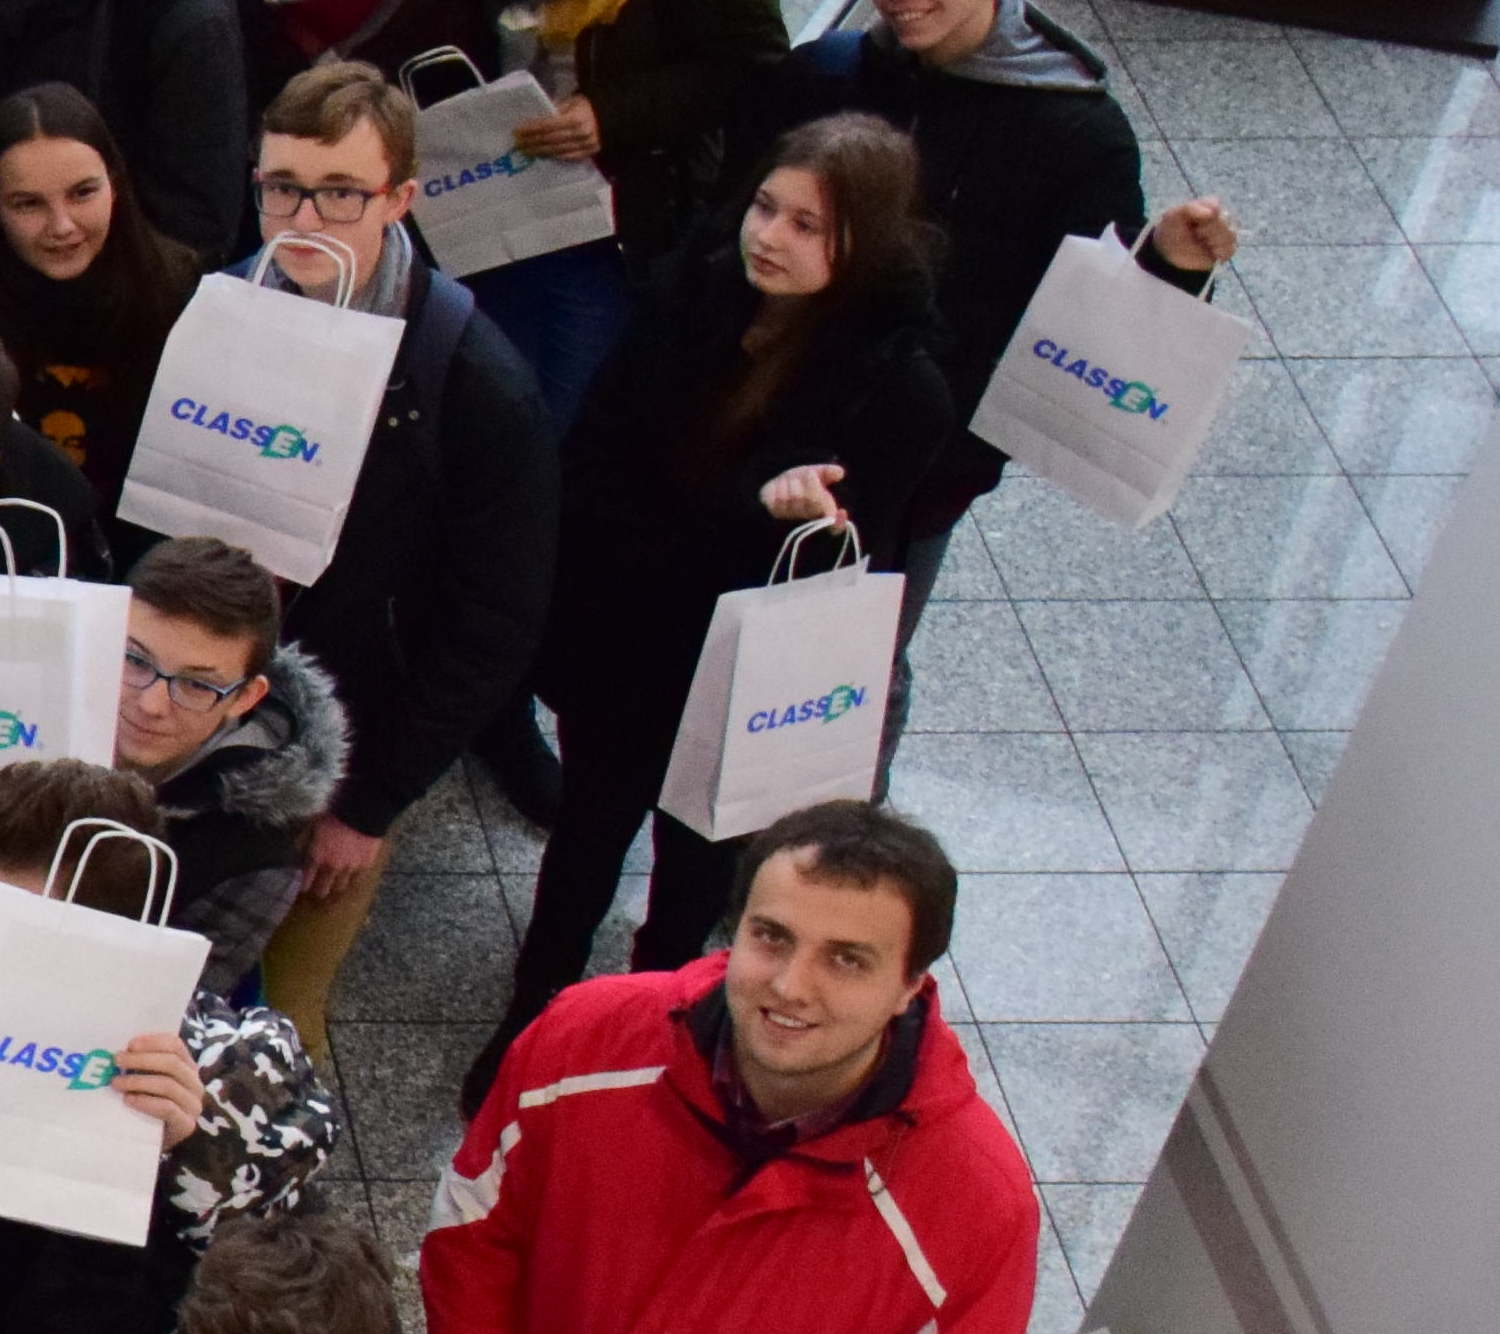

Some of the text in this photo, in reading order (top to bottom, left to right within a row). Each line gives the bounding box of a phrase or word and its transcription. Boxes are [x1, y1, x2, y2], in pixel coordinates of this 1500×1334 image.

[1033, 340, 1168, 419] CLASSEN
[171, 399, 318, 462] CLASSEN
[748, 686, 864, 731] CLASSEN
